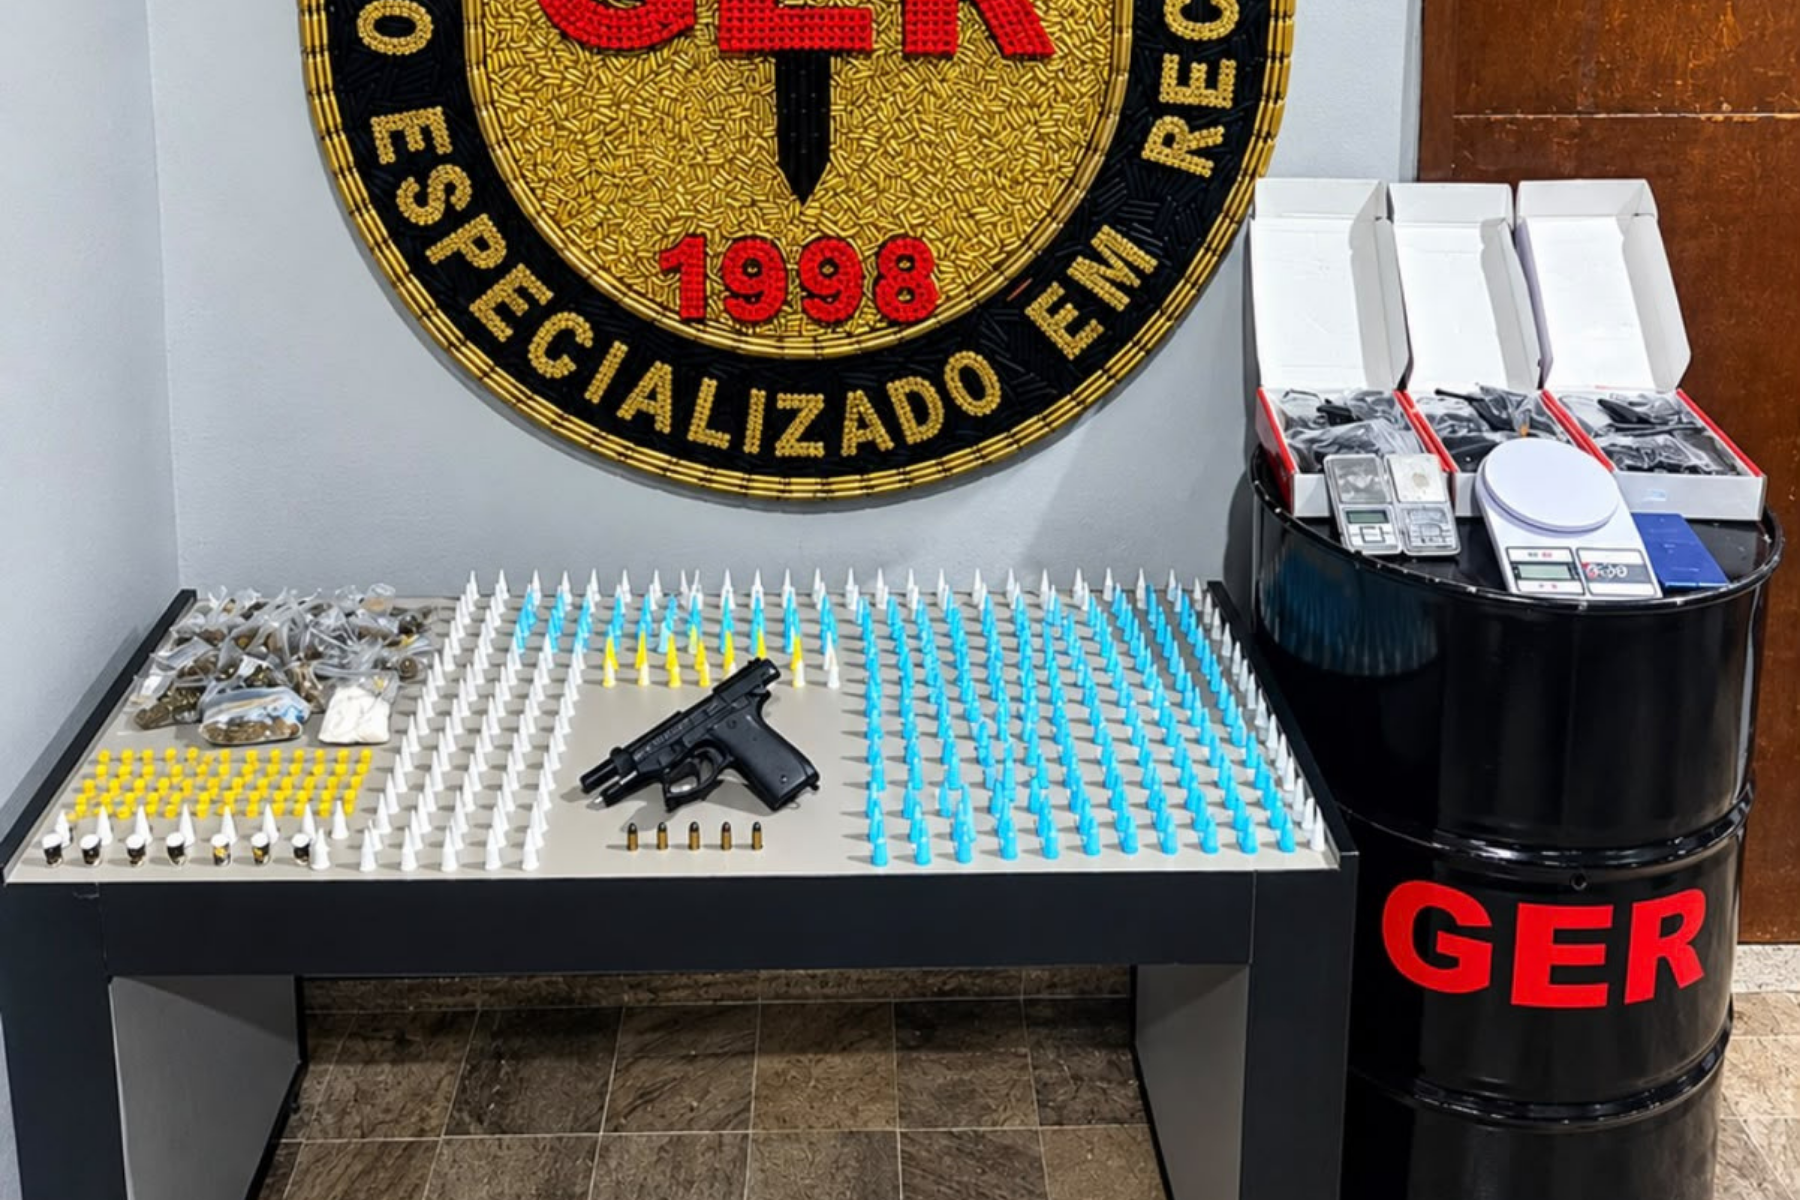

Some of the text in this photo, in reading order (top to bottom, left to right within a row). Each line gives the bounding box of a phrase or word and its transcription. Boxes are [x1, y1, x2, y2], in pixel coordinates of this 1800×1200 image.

[370, 106, 1001, 458] ESPECIALIZADO
[1024, 214, 1159, 361] EM
[658, 234, 940, 324] 1998
[1382, 880, 1707, 1009] GER
